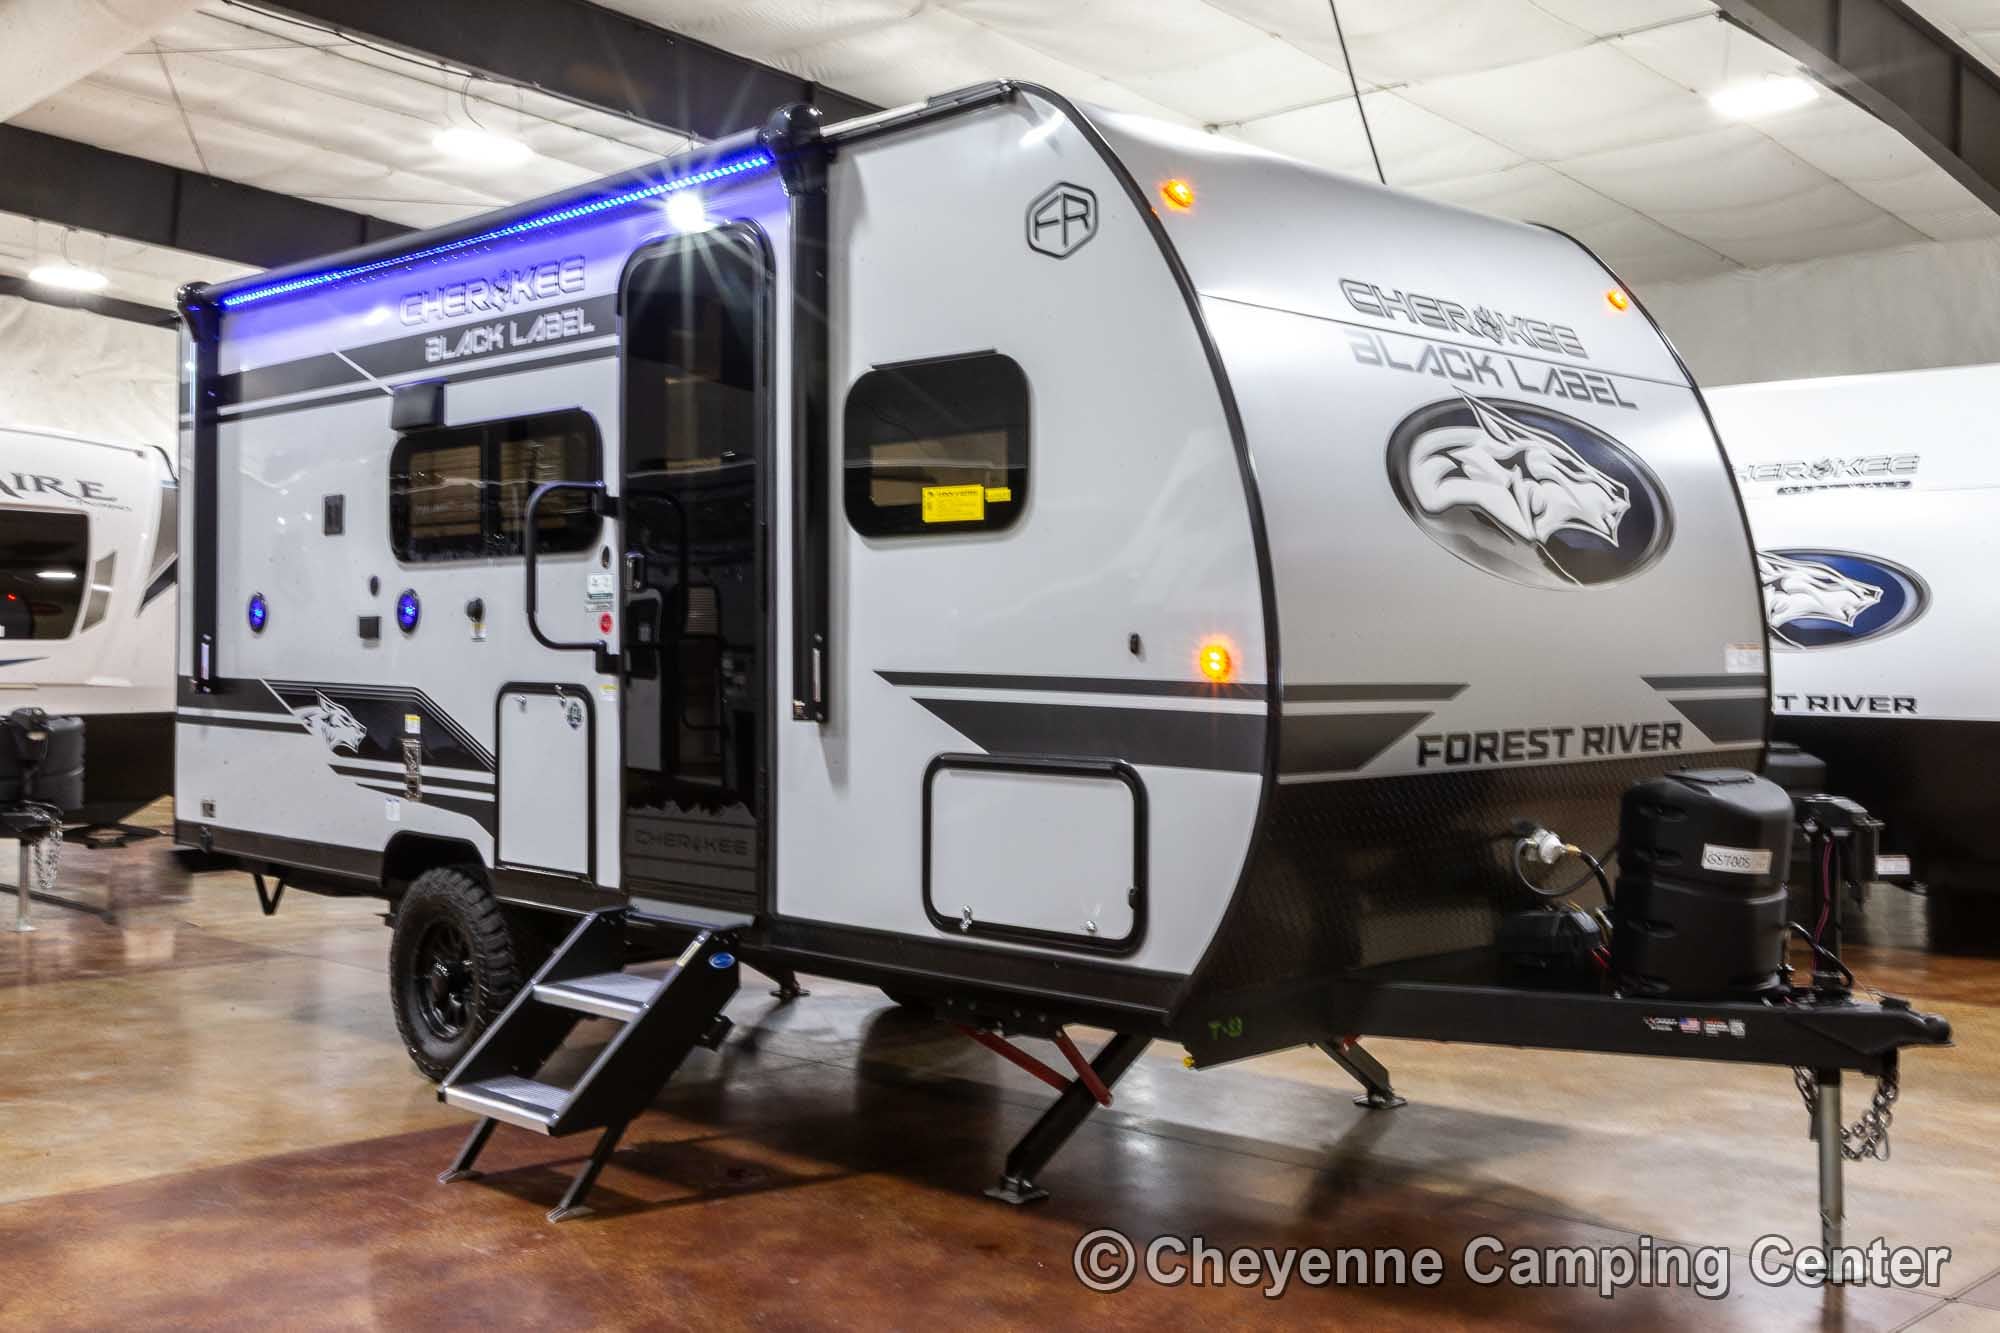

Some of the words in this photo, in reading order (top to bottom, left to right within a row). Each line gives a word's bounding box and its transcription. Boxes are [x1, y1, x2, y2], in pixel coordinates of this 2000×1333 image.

[424, 322, 505, 363] BLACK
[509, 306, 596, 347] LABEL
[1344, 326, 1504, 388] BLACK
[1507, 358, 1639, 411] LABEL
[1805, 695, 1919, 713] RIVER
[1416, 728, 1576, 767] FOREST
[1581, 722, 1682, 756] RIVER
